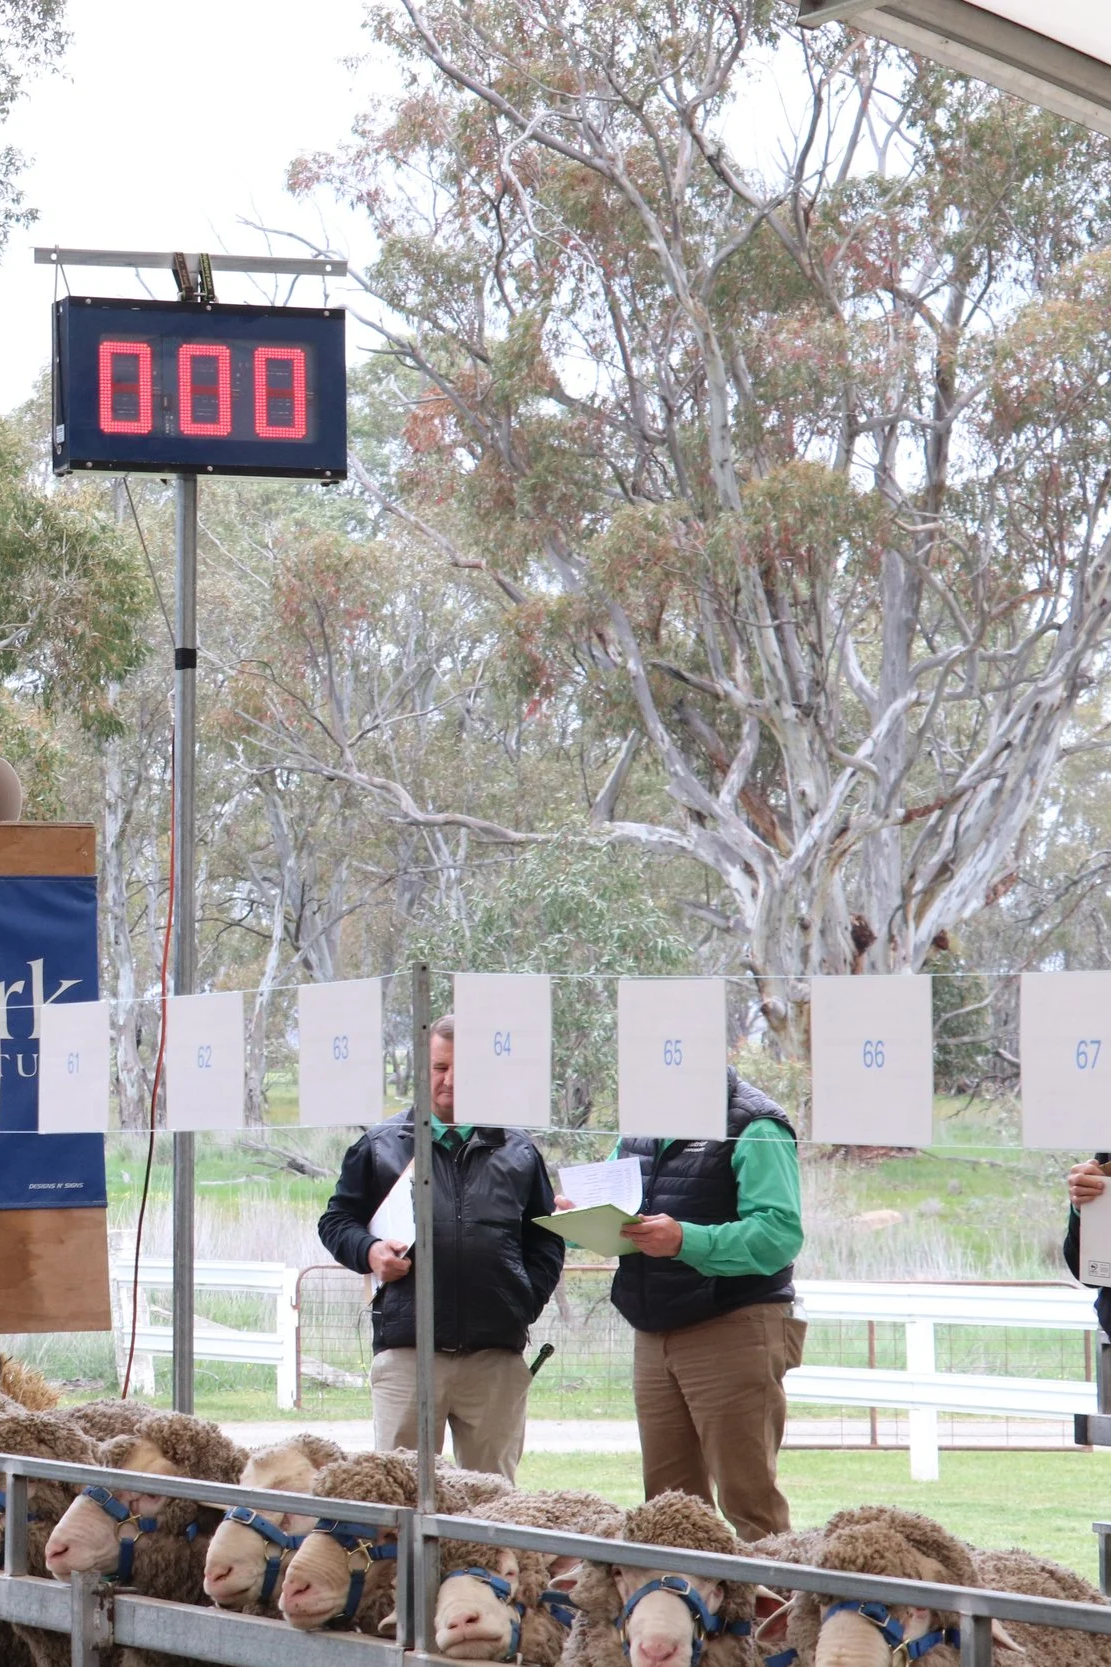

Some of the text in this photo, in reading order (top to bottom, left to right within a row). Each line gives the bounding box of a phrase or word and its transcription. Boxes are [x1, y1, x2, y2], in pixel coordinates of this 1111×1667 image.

[332, 1036, 349, 1060] 63
[494, 1031, 511, 1056] 64
[663, 1039, 683, 1066] 65
[862, 1040, 885, 1068] 66
[1076, 1039, 1102, 1069] 67
[67, 1053, 80, 1074] 61
[197, 1045, 212, 1068] 62
